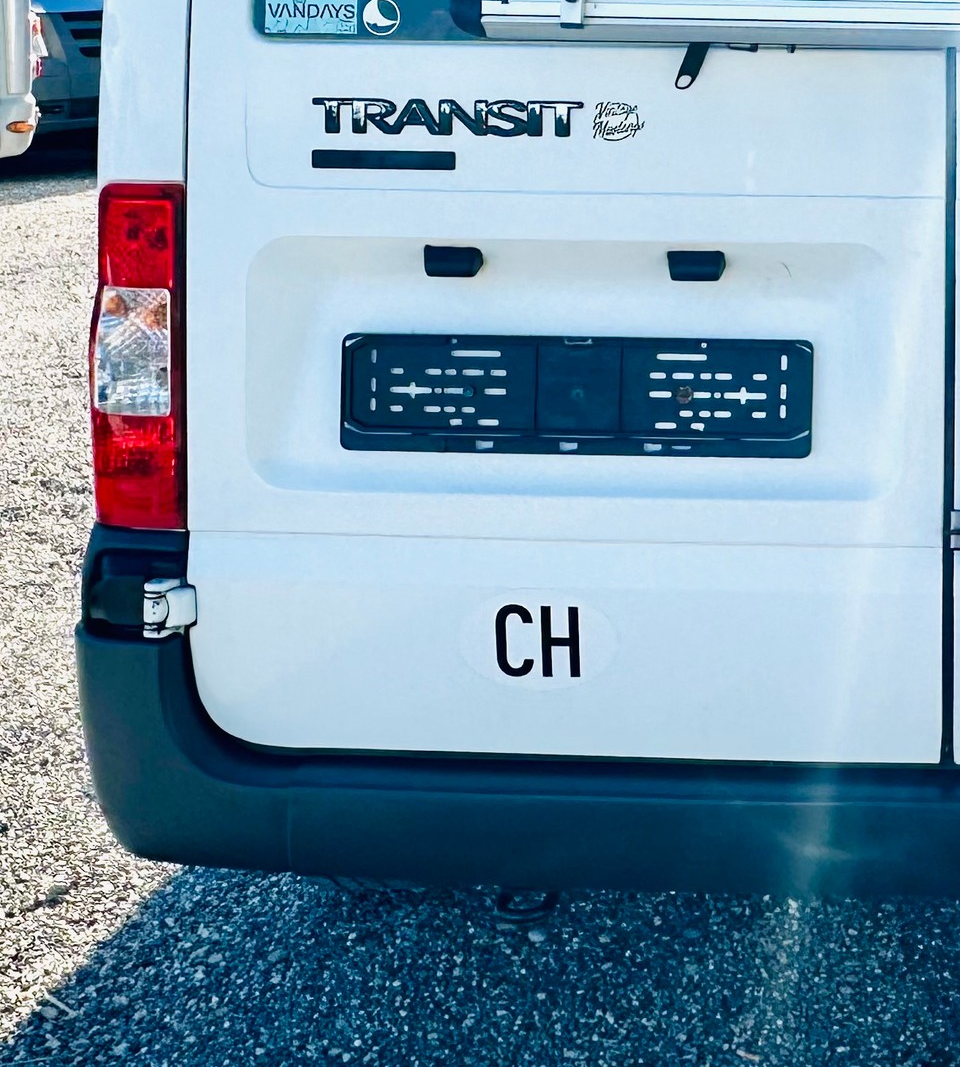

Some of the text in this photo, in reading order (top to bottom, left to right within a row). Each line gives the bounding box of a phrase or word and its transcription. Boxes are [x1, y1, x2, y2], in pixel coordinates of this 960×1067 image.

[268, 2, 355, 20] VANDAYS
[312, 97, 584, 137] TRANSIT
[495, 604, 581, 677] CH
